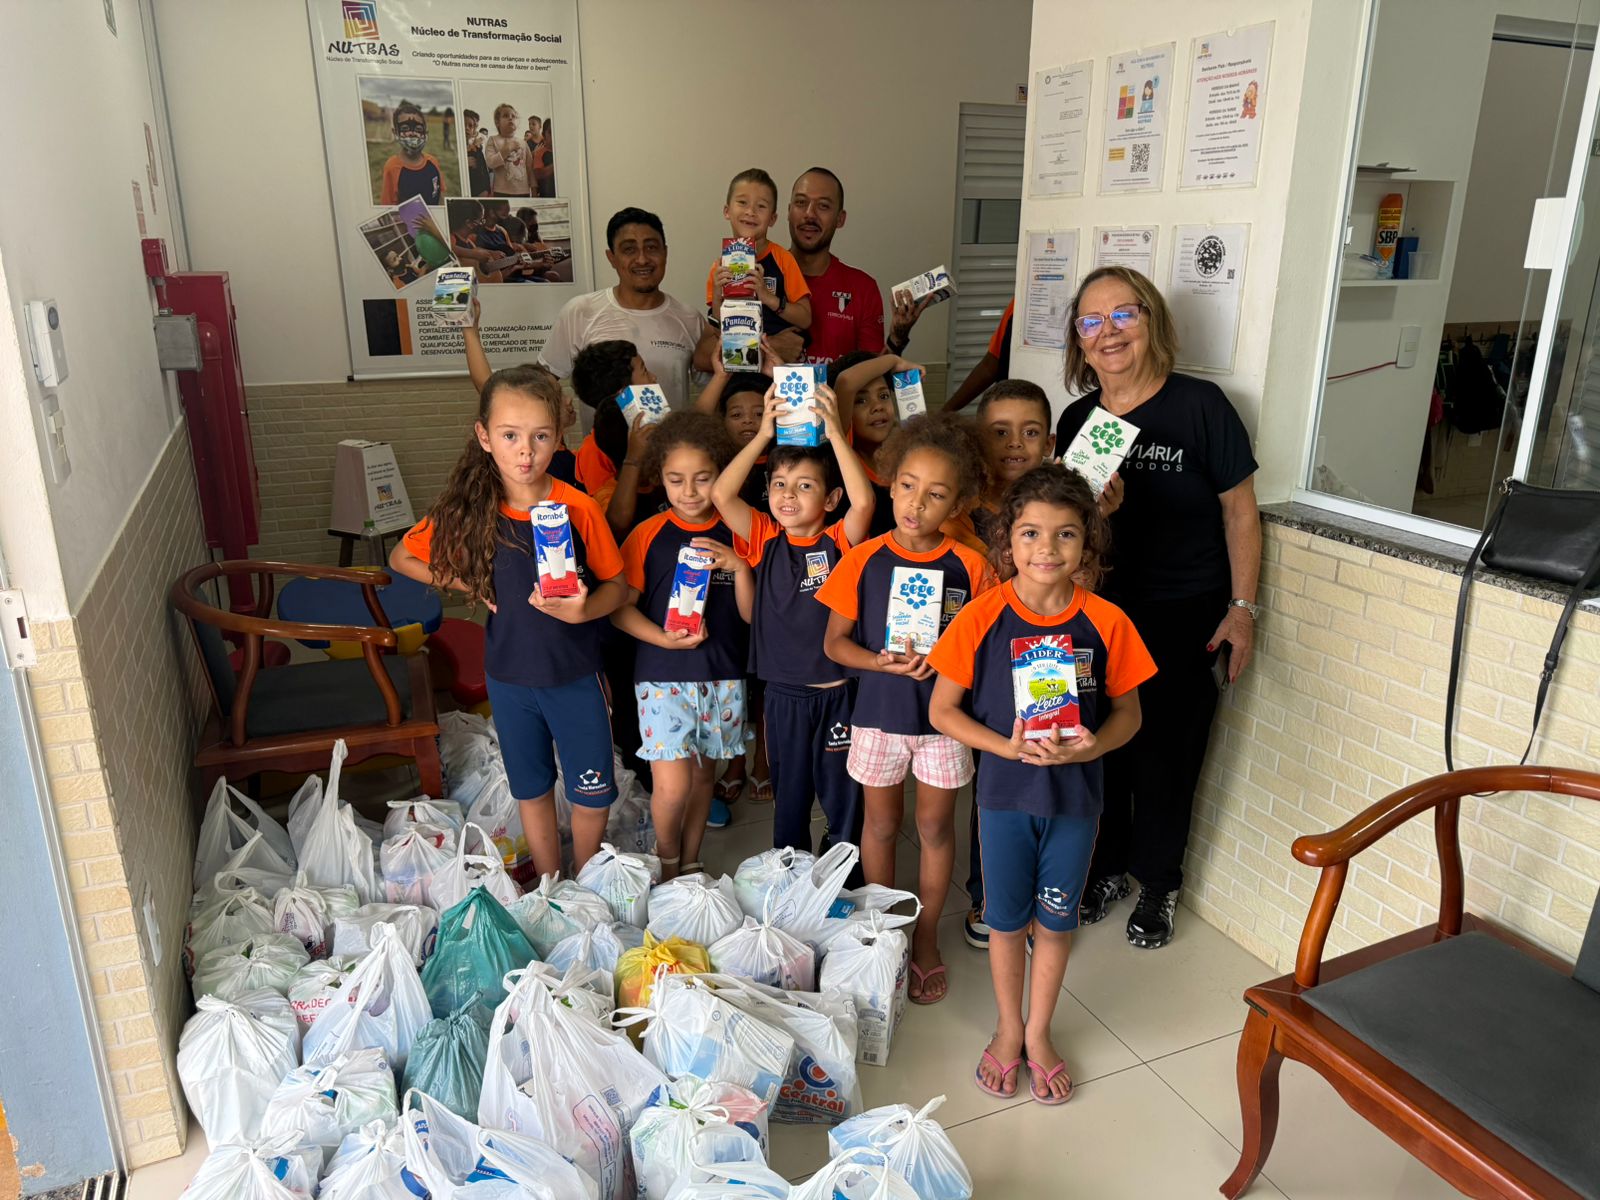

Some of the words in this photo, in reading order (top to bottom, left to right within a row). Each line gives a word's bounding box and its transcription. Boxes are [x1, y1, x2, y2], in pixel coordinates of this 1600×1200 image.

[467, 17, 508, 28] NUTRAS
[411, 26, 445, 36] Núcleo
[448, 29, 459, 37] de
[462, 29, 532, 42] Transformação
[534, 34, 562, 43] Social
[328, 41, 400, 56] NUTRAS
[1378, 230, 1398, 244] SBP
[780, 382, 808, 395] gege
[640, 396, 663, 406] gege
[1089, 424, 1125, 448] gege
[1125, 461, 1182, 472] TODOS
[900, 583, 935, 599] gege
[1026, 650, 1063, 661] LIDER
[1033, 695, 1063, 713] Leite
[779, 1084, 846, 1116] Central
